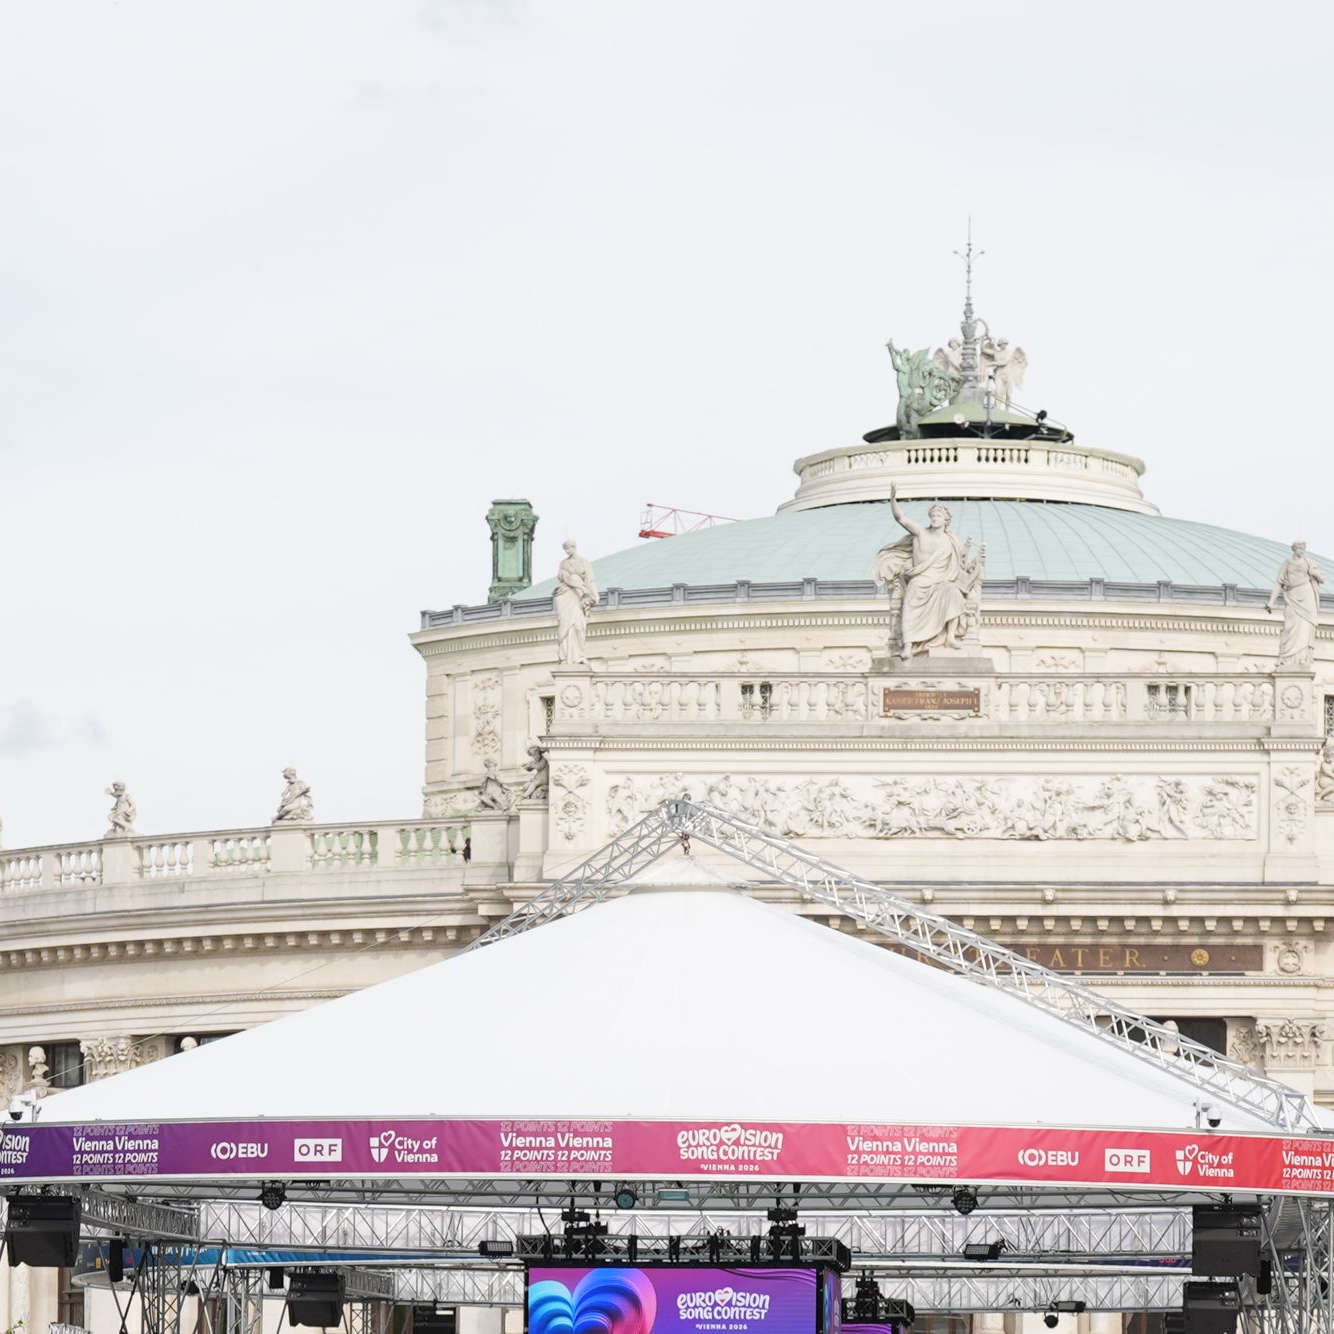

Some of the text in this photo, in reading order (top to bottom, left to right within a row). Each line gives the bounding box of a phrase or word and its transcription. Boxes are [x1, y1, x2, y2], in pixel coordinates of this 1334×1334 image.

[72, 1136, 159, 1151] Vienna Vienna
[499, 1132, 613, 1148] Vienna Vienna
[676, 1123, 784, 1149] EUROVISION
[238, 1142, 269, 1158] EBU
[298, 1143, 338, 1157] ORF
[394, 1136, 438, 1152] City of
[846, 1136, 958, 1153] Vienna Vienna
[72, 1152, 158, 1164] 12 POINTS 12 POINTS
[395, 1151, 438, 1163] Vienna
[500, 1149, 612, 1161] 12 POINTS 12 POINTS
[679, 1147, 782, 1161] SONG CONTEST
[846, 1154, 958, 1167] 12 POINTS 12 POINTS
[1047, 1151, 1079, 1167] EBU
[1109, 1153, 1146, 1168] ORF
[1197, 1150, 1234, 1166] City of
[1282, 1151, 1323, 1166] Vienna
[700, 1163, 760, 1172] VIENNA 2026
[1197, 1165, 1235, 1178] Vienna
[1282, 1168, 1291, 1179] 12
[1291, 1169, 1323, 1180] POINTS
[1323, 1170, 1332, 1180] 12
[676, 1286, 770, 1310] EUROVISION
[679, 1307, 768, 1320] SONG CONTEST
